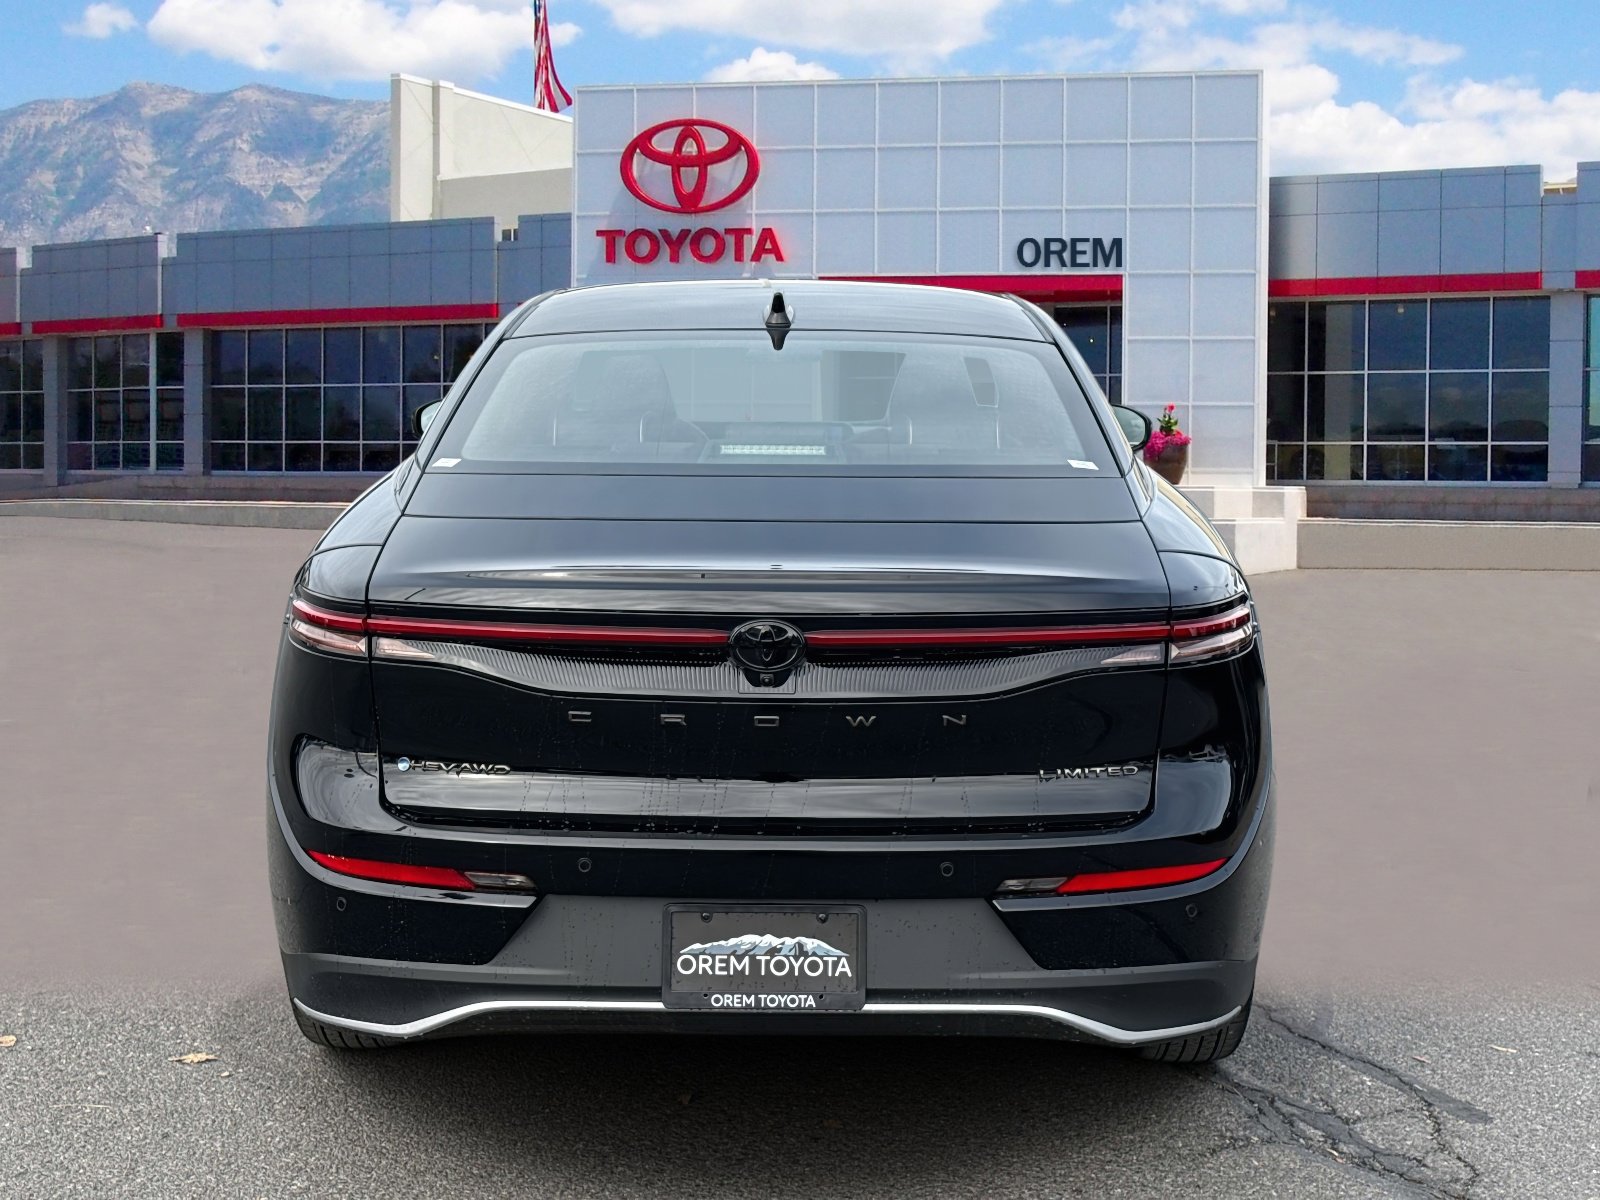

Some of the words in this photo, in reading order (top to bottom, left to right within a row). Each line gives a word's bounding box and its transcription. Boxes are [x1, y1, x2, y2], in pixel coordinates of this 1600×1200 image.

[596, 227, 784, 265] TOYOTA
[1016, 237, 1123, 268] OREM
[568, 710, 967, 727] CROWN
[1038, 765, 1139, 782] LIMITED
[676, 954, 750, 976] OREM
[755, 954, 852, 977] TOYOTA
[710, 993, 755, 1008] OREM
[758, 994, 816, 1008] TOYOTA
